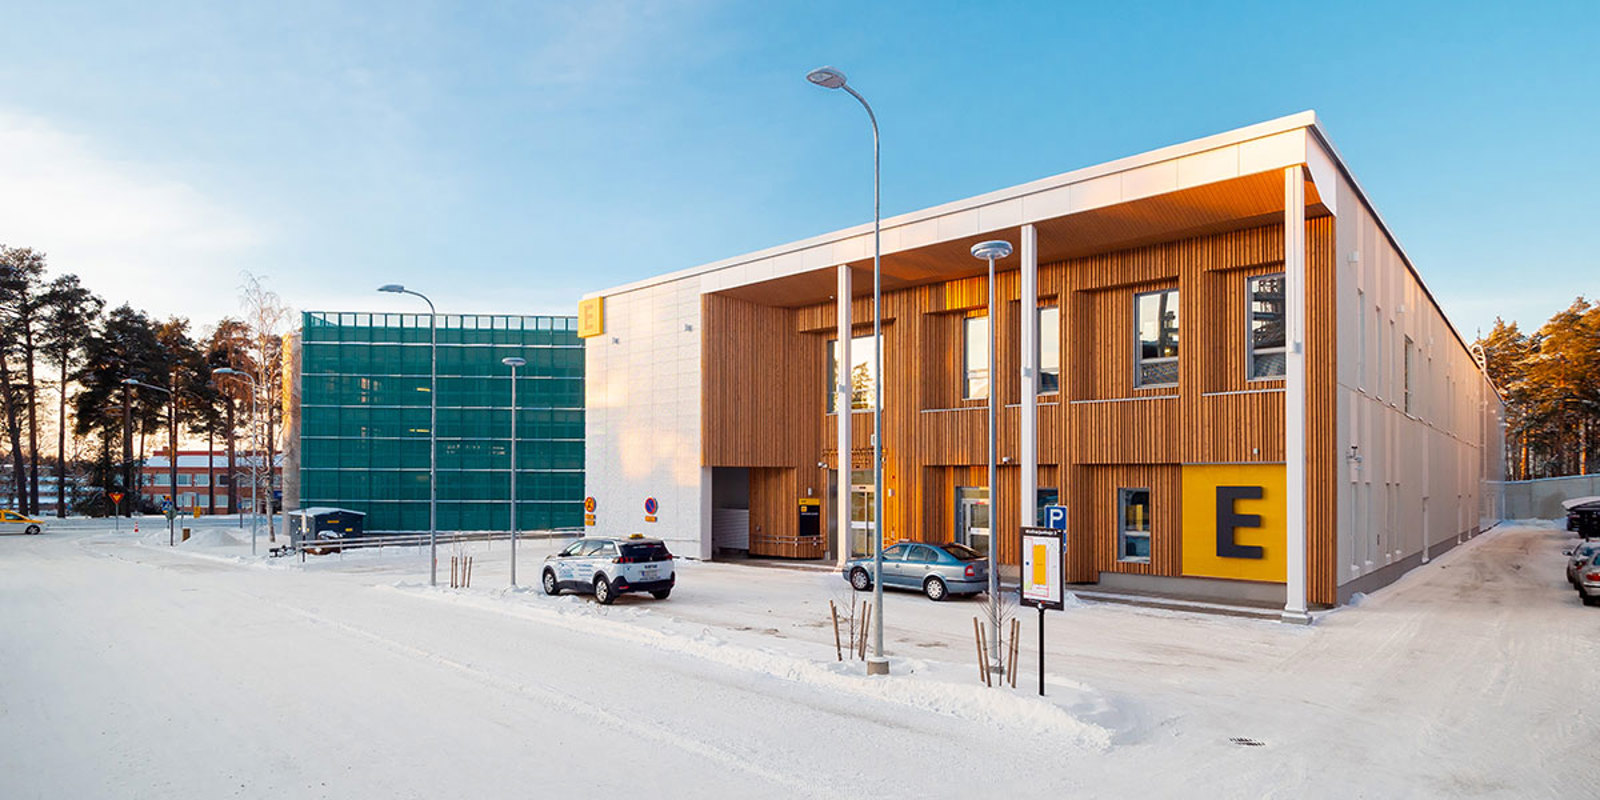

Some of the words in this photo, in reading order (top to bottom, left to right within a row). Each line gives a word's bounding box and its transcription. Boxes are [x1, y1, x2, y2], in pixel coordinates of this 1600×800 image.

[584, 304, 593, 330] E
[1050, 508, 1063, 528] P
[1216, 486, 1263, 559] E
